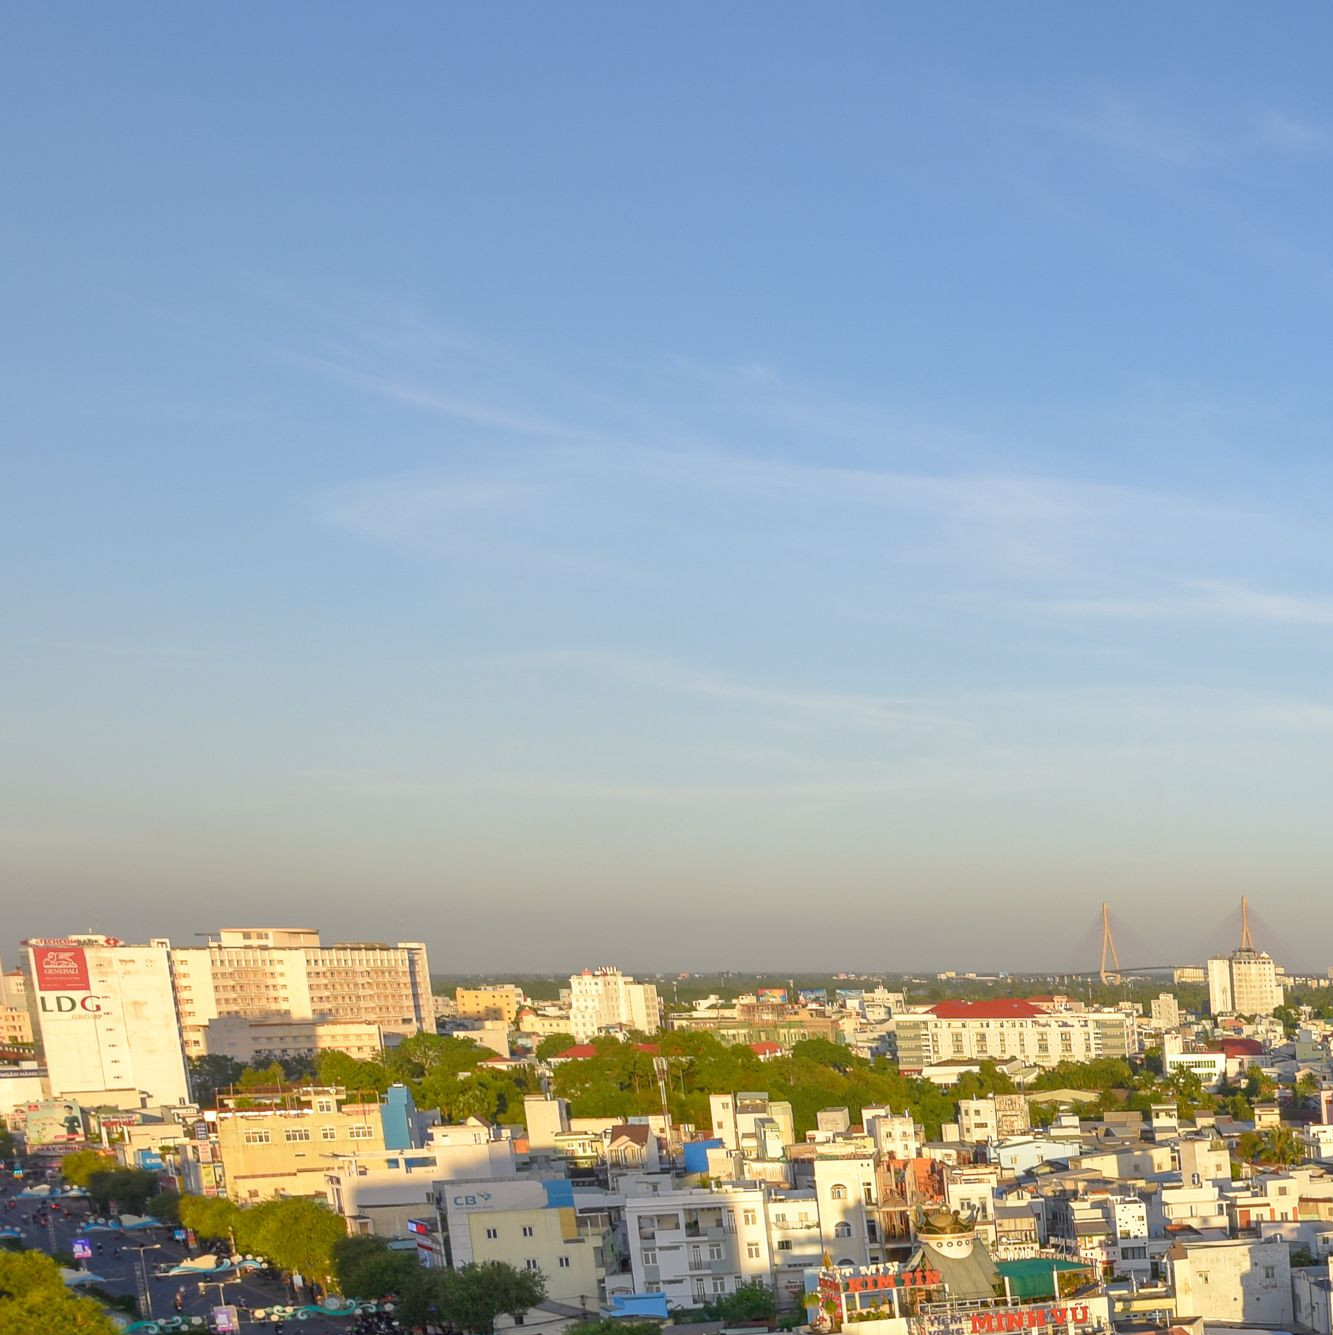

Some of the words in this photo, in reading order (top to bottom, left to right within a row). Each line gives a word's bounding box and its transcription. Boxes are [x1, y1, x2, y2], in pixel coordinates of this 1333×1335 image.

[40, 995, 102, 1012] LDG
[454, 1195, 477, 1206] CB
[849, 1275, 895, 1292] KIM
[970, 1309, 1046, 1334] MINH
[1052, 1302, 1089, 1326] VŨ
